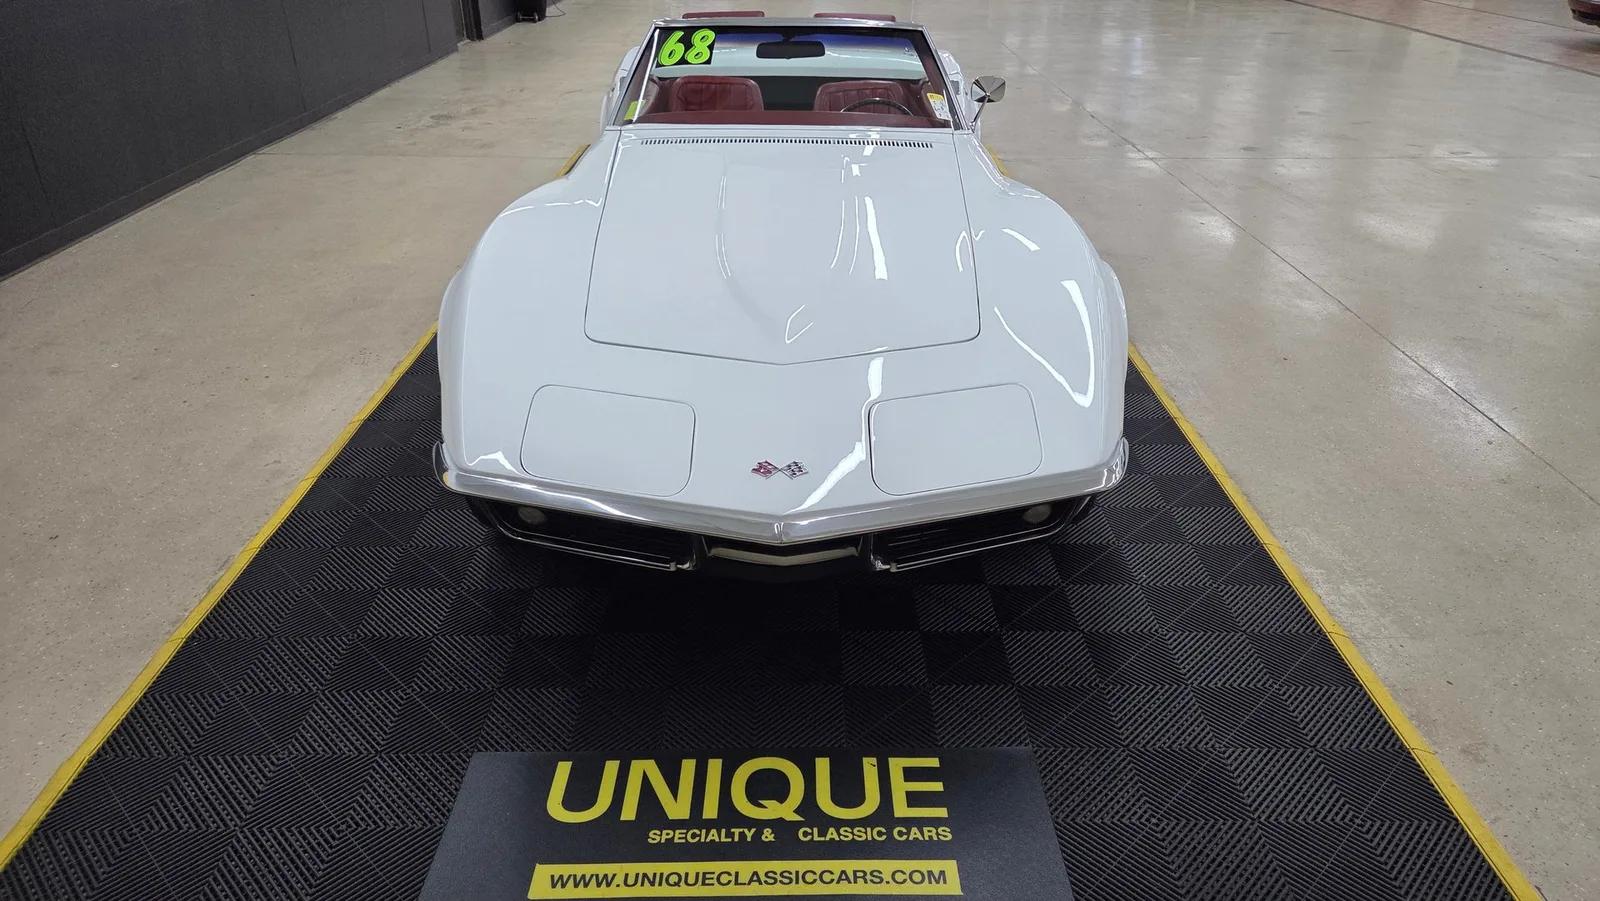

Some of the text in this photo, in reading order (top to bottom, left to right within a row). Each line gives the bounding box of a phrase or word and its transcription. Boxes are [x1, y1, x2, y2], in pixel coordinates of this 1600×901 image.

[658, 28, 716, 65] 68
[547, 757, 949, 823] UNIQUE
[648, 826, 952, 844] SPECIALTY & CLASSIC CARS
[550, 870, 948, 889] WWW.UNIQUECLASSICCARS.COM
